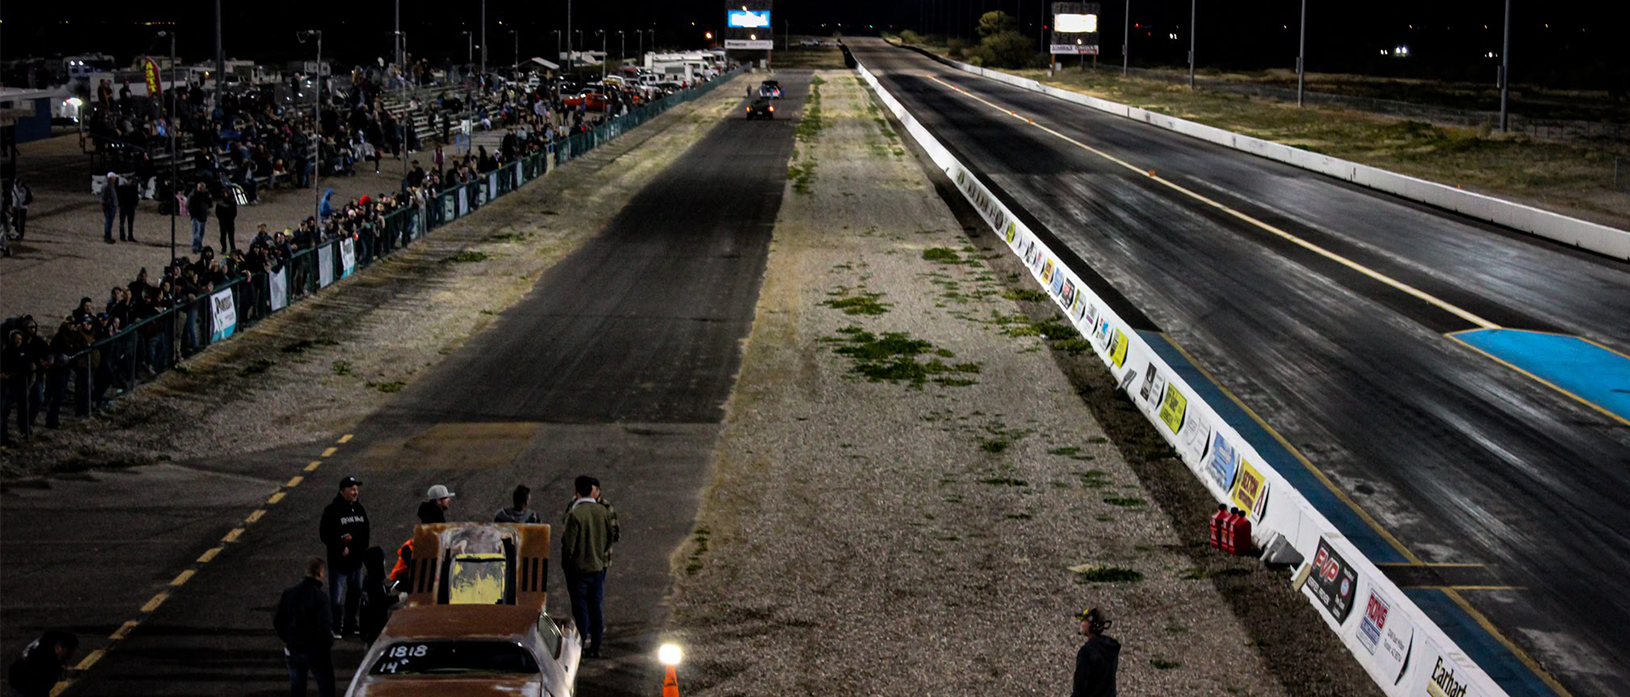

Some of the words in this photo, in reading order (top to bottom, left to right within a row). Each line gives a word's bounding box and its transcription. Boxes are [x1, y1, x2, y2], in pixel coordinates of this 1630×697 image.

[1312, 546, 1339, 582] FVP
[389, 645, 428, 657] 1818
[1431, 655, 1468, 697] Earhart
